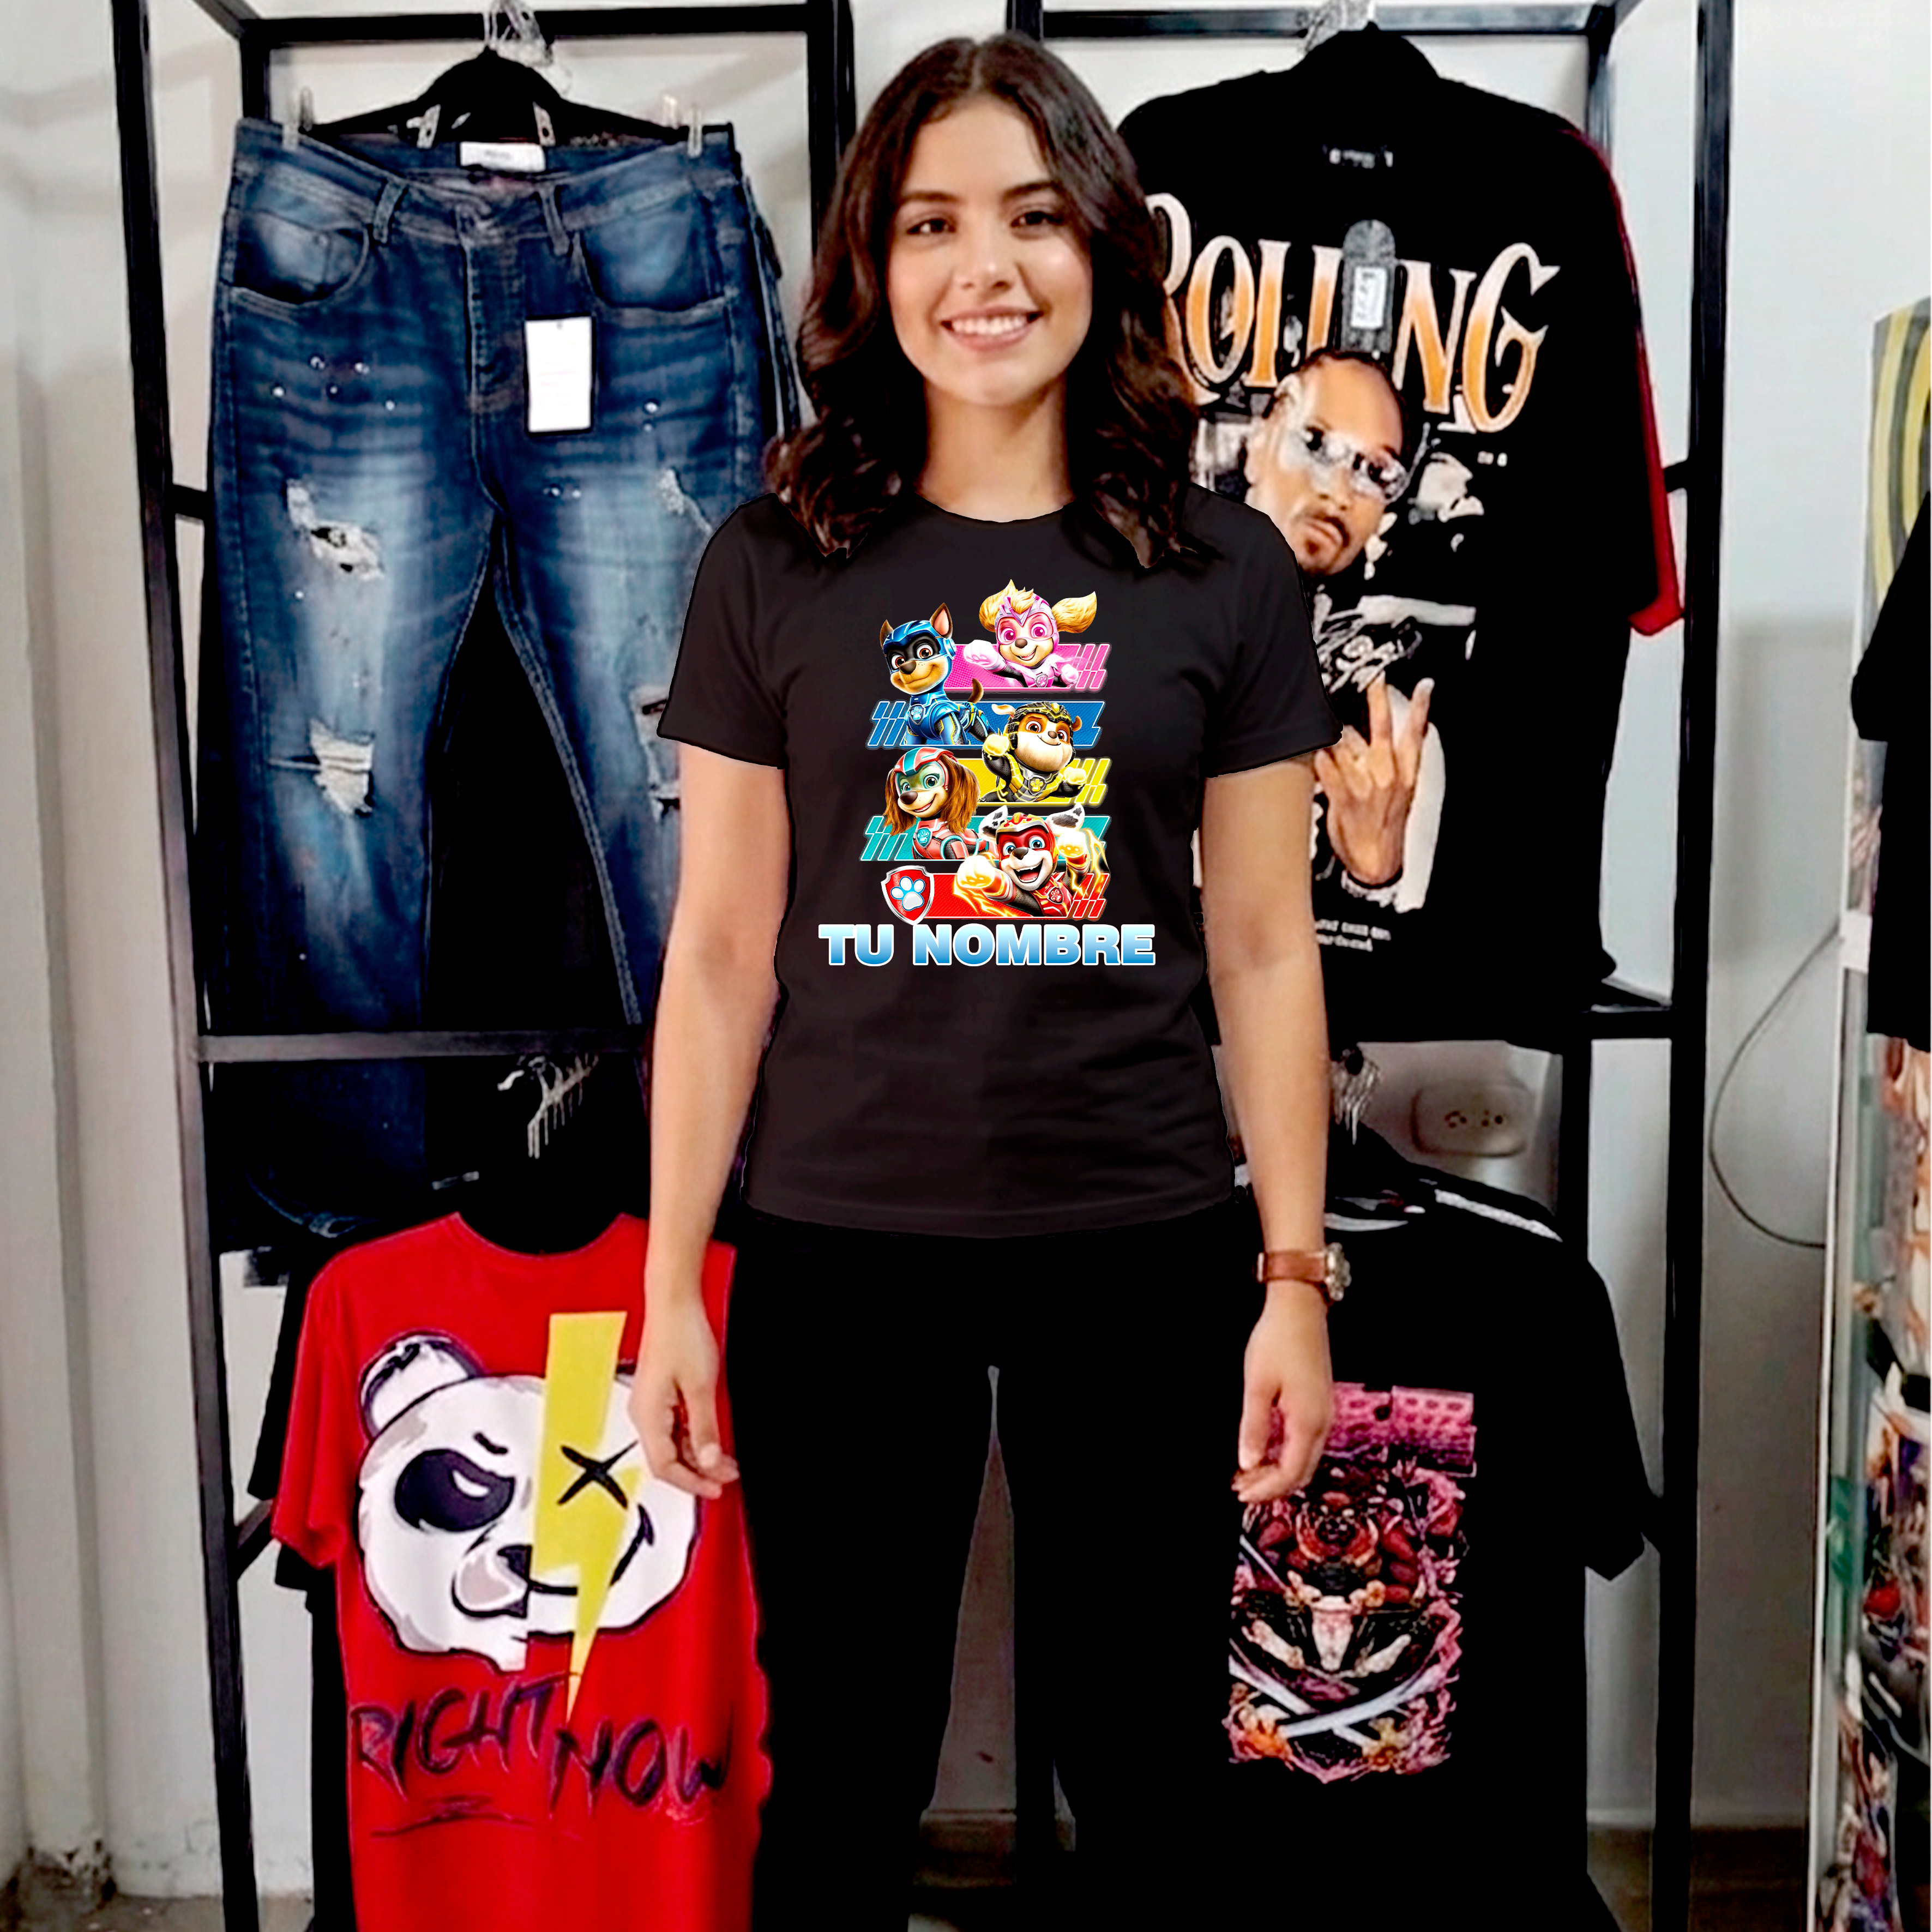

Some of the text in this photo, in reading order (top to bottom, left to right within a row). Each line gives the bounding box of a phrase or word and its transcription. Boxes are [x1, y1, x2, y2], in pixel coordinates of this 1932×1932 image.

[1146, 192, 1561, 432] ROLLNG
[818, 923, 1155, 967] TU NOMBRE
[349, 1672, 735, 1817] RIGHT NOW
